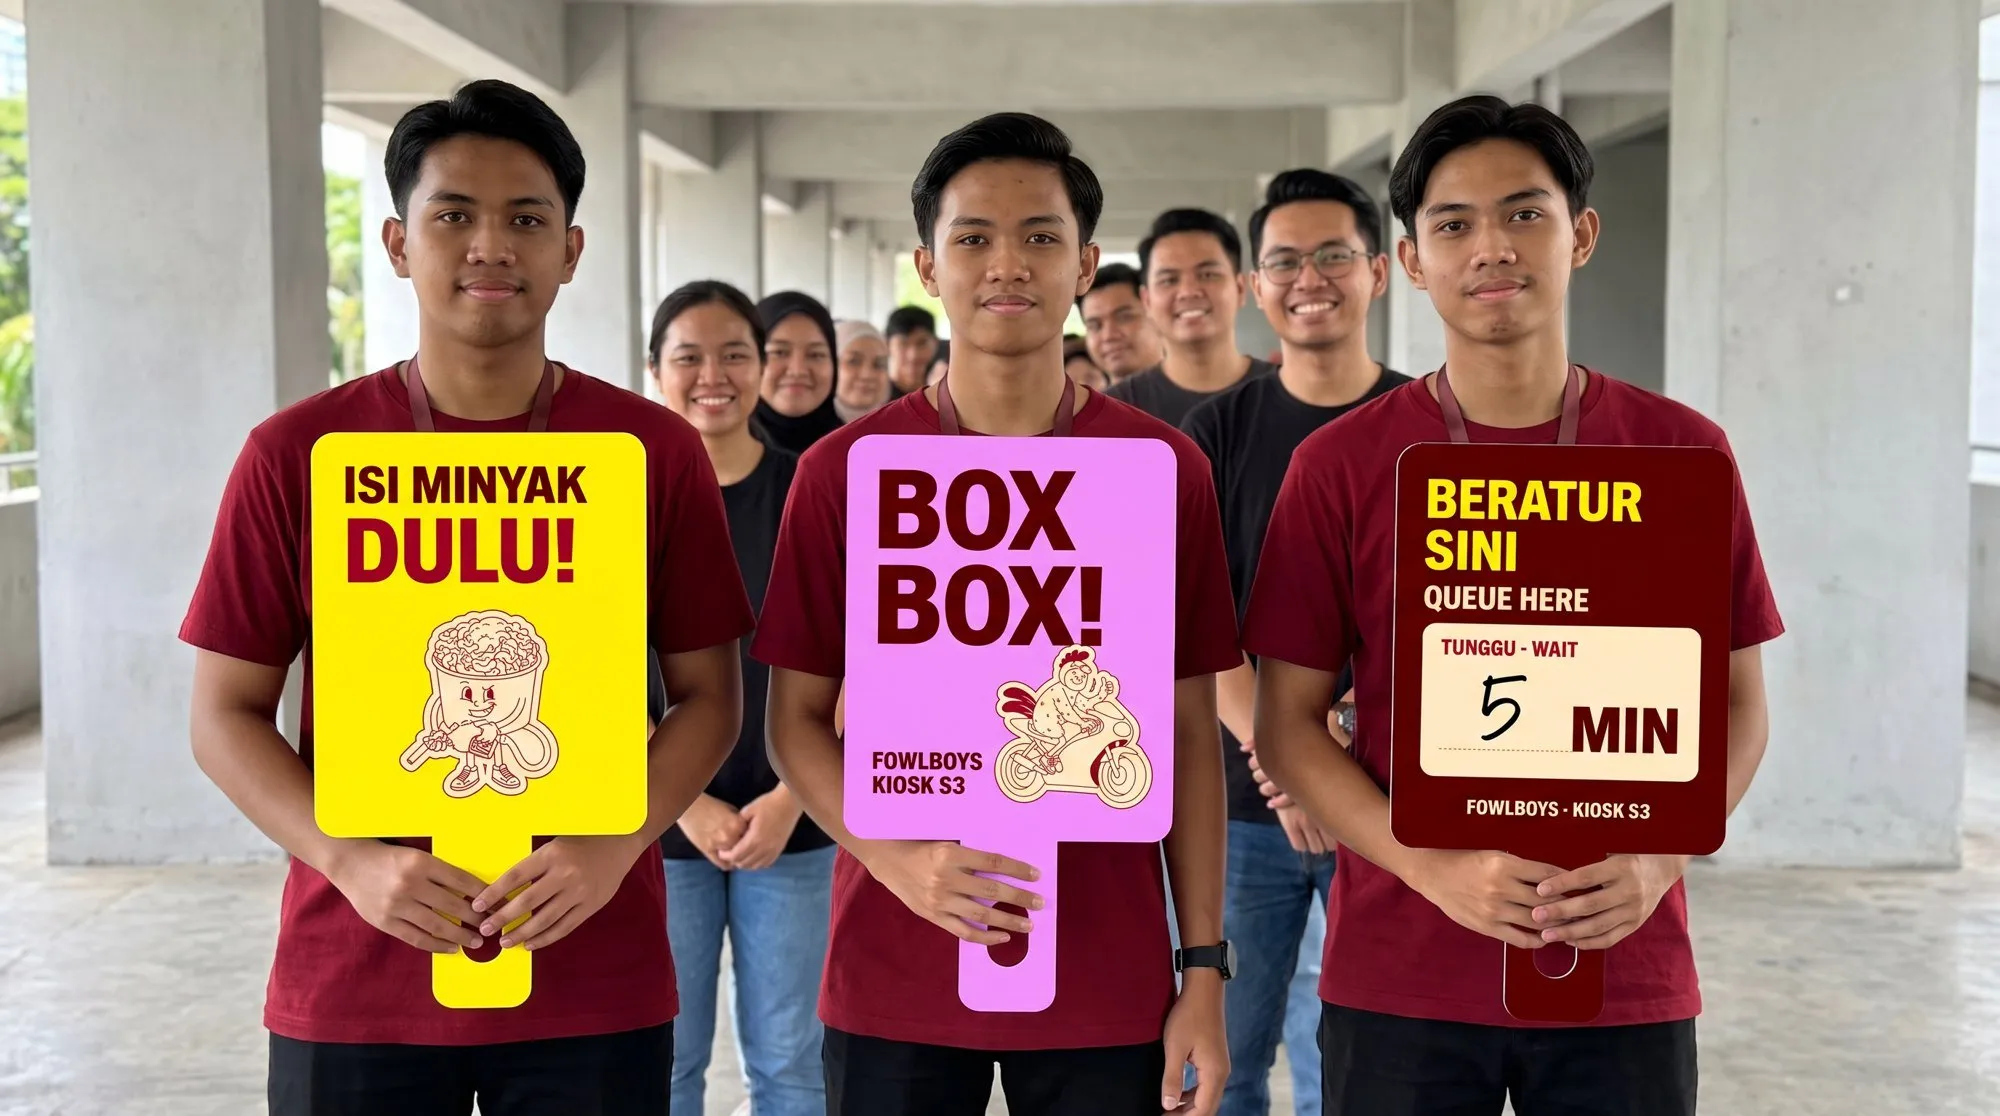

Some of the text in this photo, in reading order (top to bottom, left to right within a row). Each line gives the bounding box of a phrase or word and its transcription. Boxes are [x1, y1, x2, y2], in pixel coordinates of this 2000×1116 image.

[345, 466, 587, 504] ISI MINYAK
[1427, 479, 1642, 522] BERATUR
[878, 469, 1076, 551] BOX
[347, 518, 574, 584] DULU!
[1425, 530, 1517, 571] SINI
[877, 564, 1103, 646] BOX!
[1424, 585, 1589, 613] QUEUE HERE
[1441, 639, 1515, 656] TUNGGU
[1532, 641, 1578, 658] WAIT
[1481, 675, 1527, 741] 5
[1572, 706, 1678, 754] MIN
[872, 752, 983, 771] FOWLBOYS
[872, 776, 965, 795] KIOSK S3
[1466, 799, 1559, 817] FOWLBOYS
[1573, 802, 1624, 819] KIOSK
[1629, 804, 1650, 820] S3
